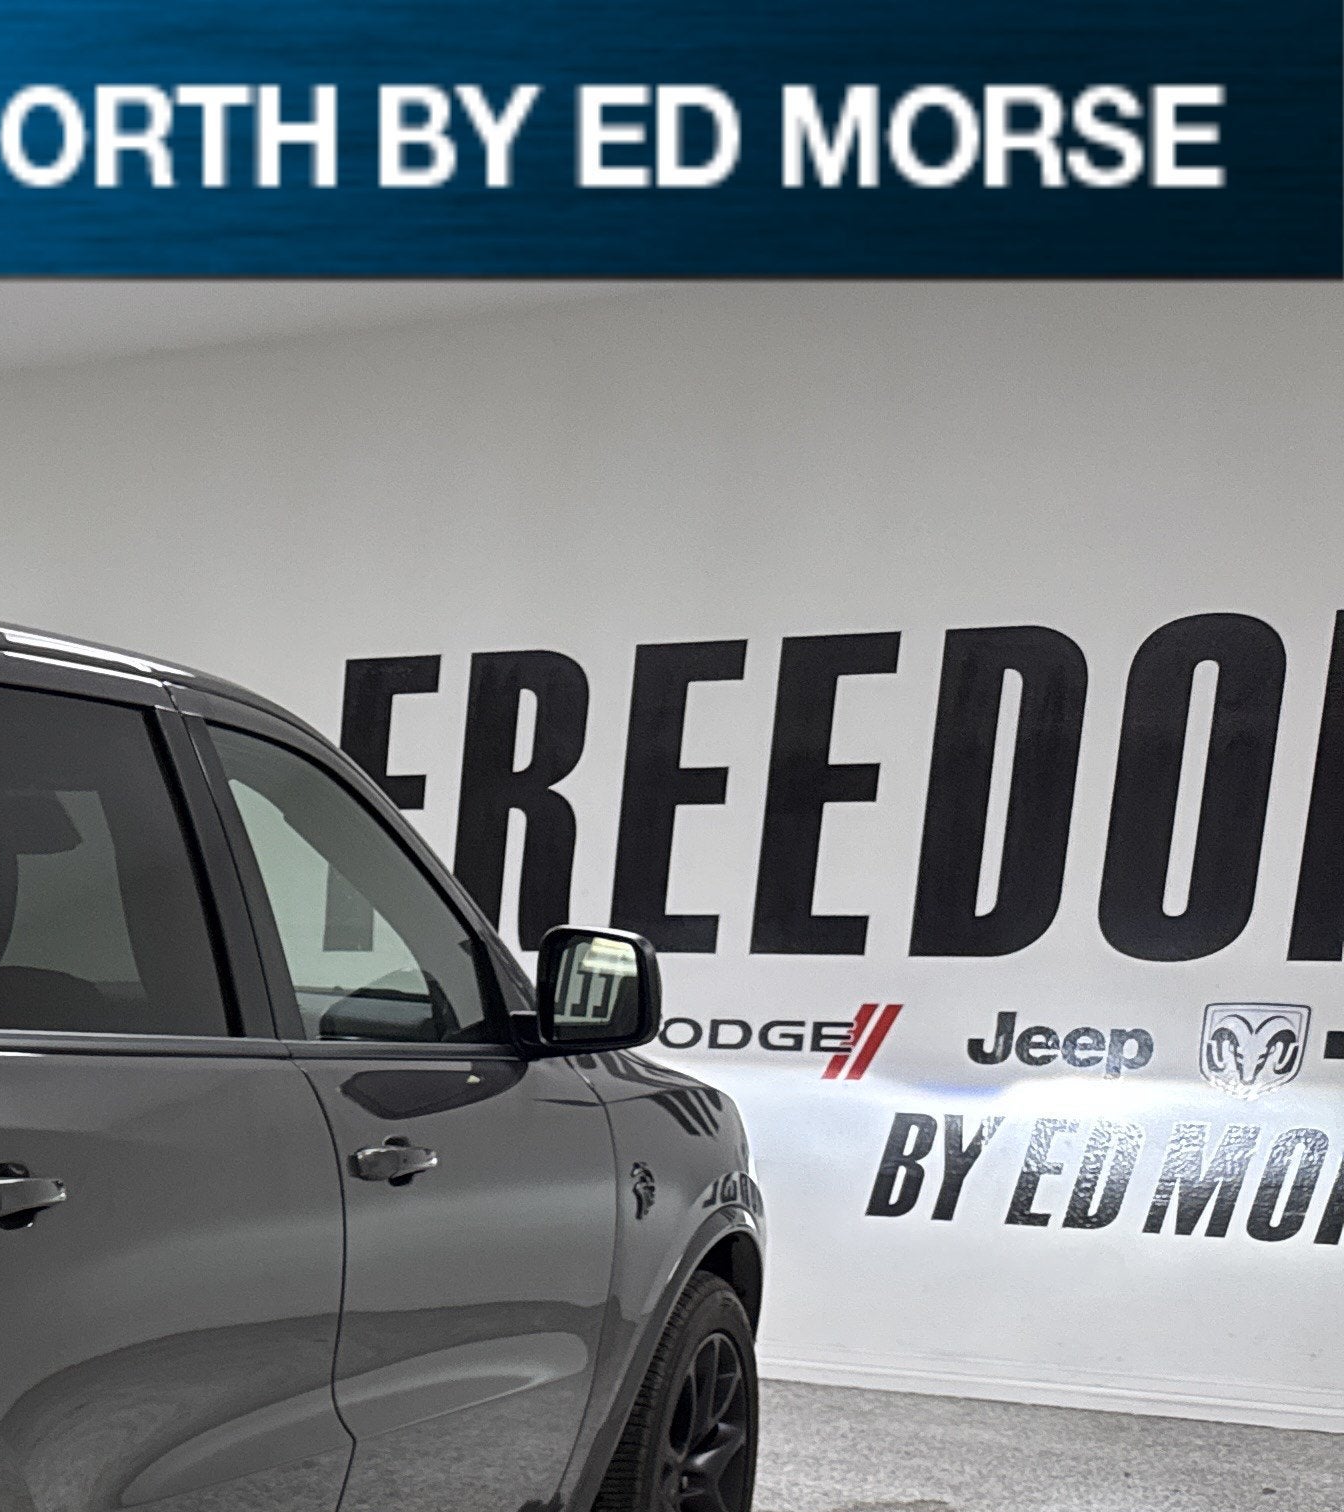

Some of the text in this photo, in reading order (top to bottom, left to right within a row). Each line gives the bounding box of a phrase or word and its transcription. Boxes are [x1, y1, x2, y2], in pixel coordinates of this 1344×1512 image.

[658, 1016, 855, 1053] ODGE
[967, 1011, 1154, 1079] Jeep
[865, 1112, 1006, 1221] BY
[1004, 1116, 1146, 1230] ED
